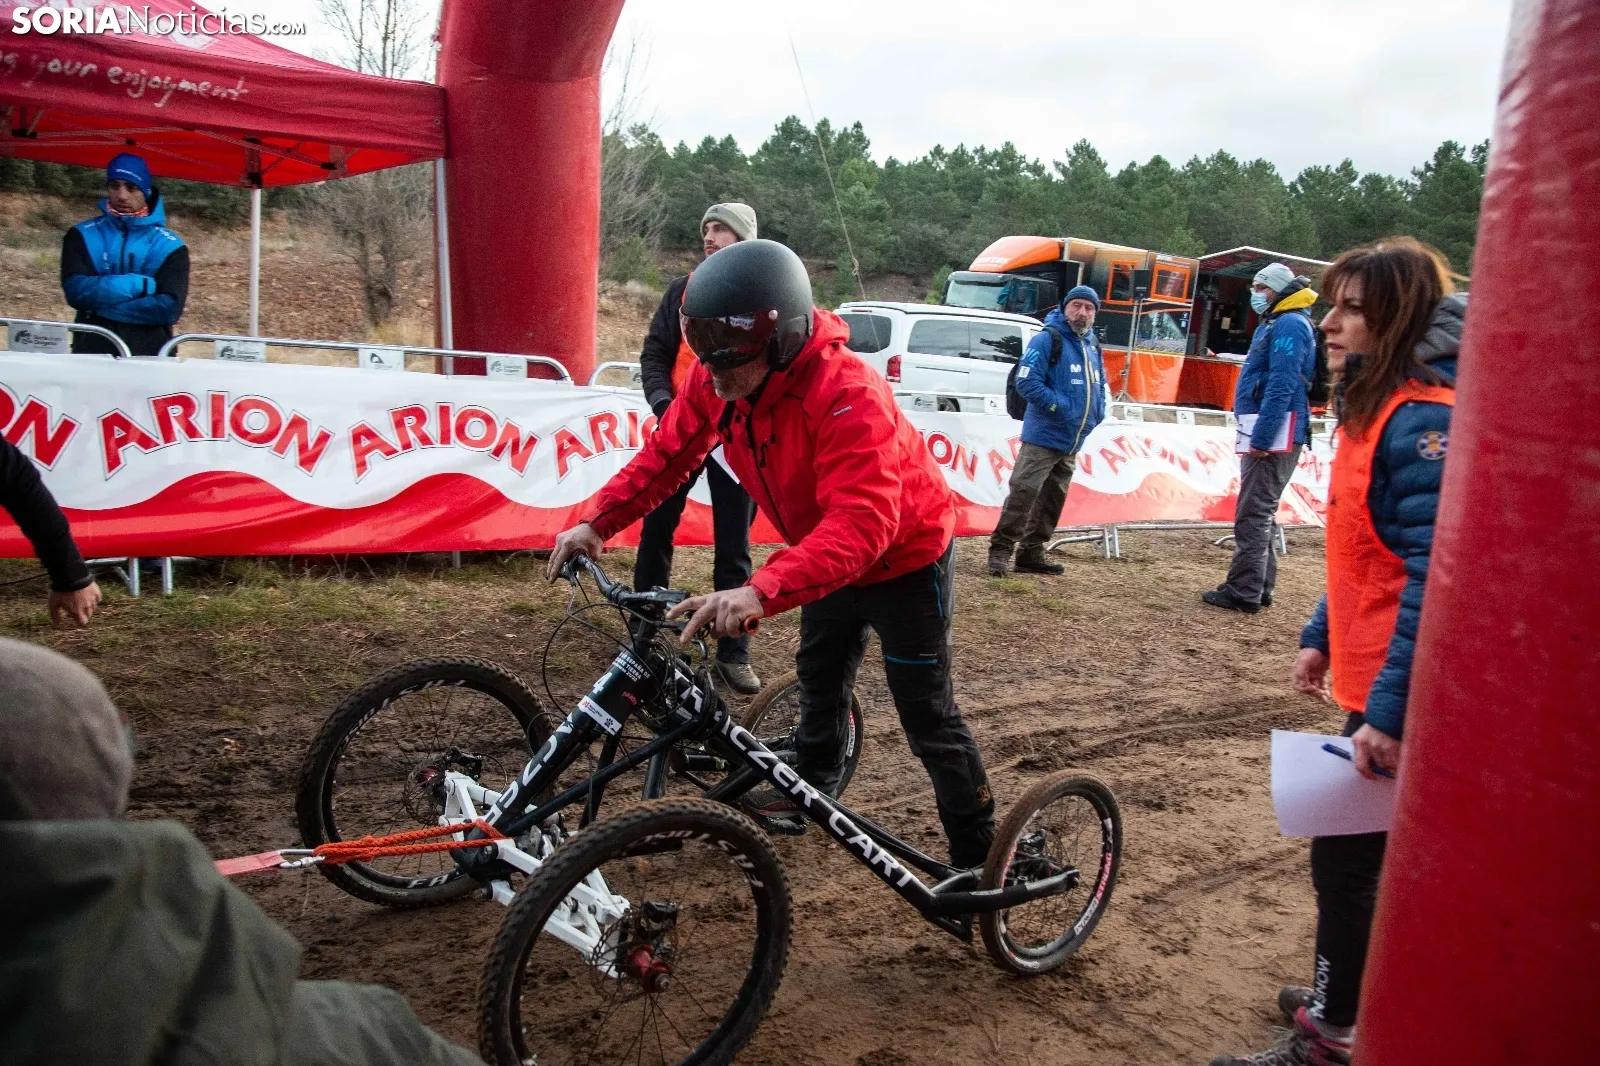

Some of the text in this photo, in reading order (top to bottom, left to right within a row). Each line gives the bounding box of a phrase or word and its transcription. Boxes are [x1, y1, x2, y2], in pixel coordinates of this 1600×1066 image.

[106, 65, 249, 108] enjoyment
[97, 390, 335, 481] ARION
[348, 401, 541, 484] ARION
[917, 428, 979, 483] ON
[1099, 433, 1191, 476] ARION
[625, 663, 642, 679] TIERRA
[829, 811, 921, 888] CART
